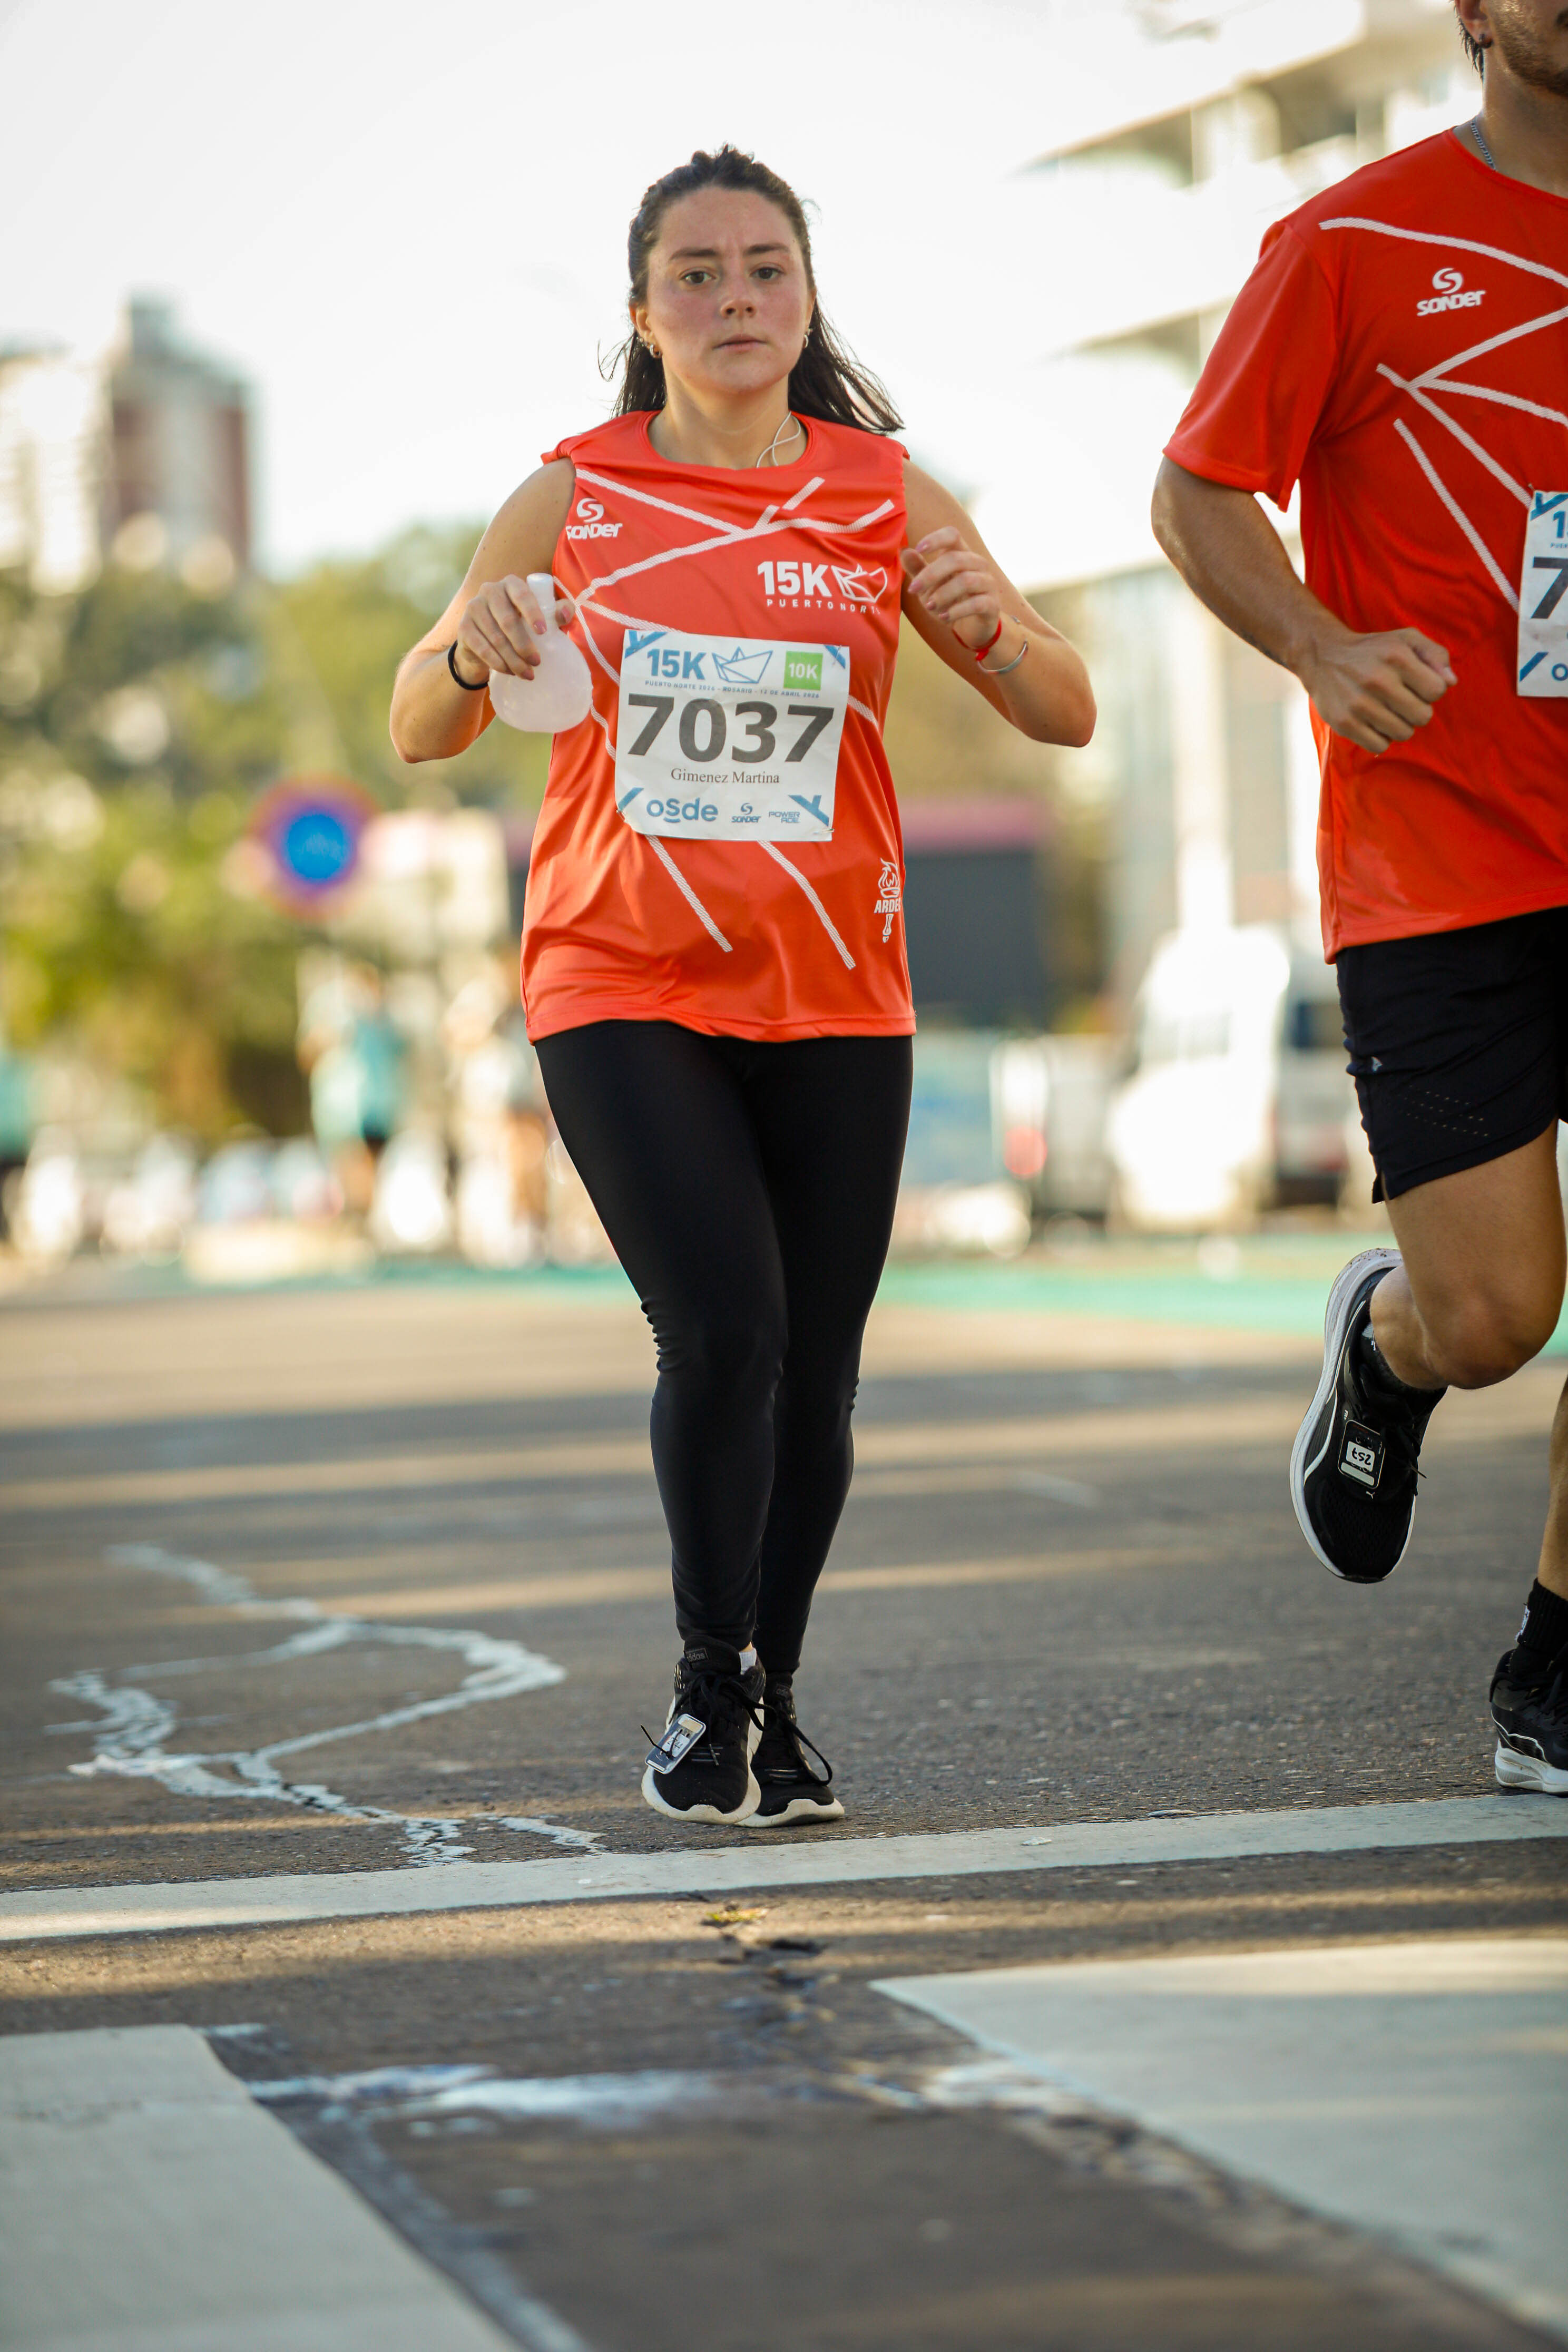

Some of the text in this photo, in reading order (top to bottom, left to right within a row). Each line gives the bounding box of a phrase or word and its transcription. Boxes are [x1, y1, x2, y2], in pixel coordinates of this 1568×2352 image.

[1553, 510, 1568, 538] 1
[757, 561, 832, 597] 15K
[767, 599, 834, 610] PUERTO
[647, 649, 707, 680] 15K
[789, 663, 817, 679] 10K
[628, 693, 835, 763] 7037
[671, 768, 779, 783] Gimenez Martina
